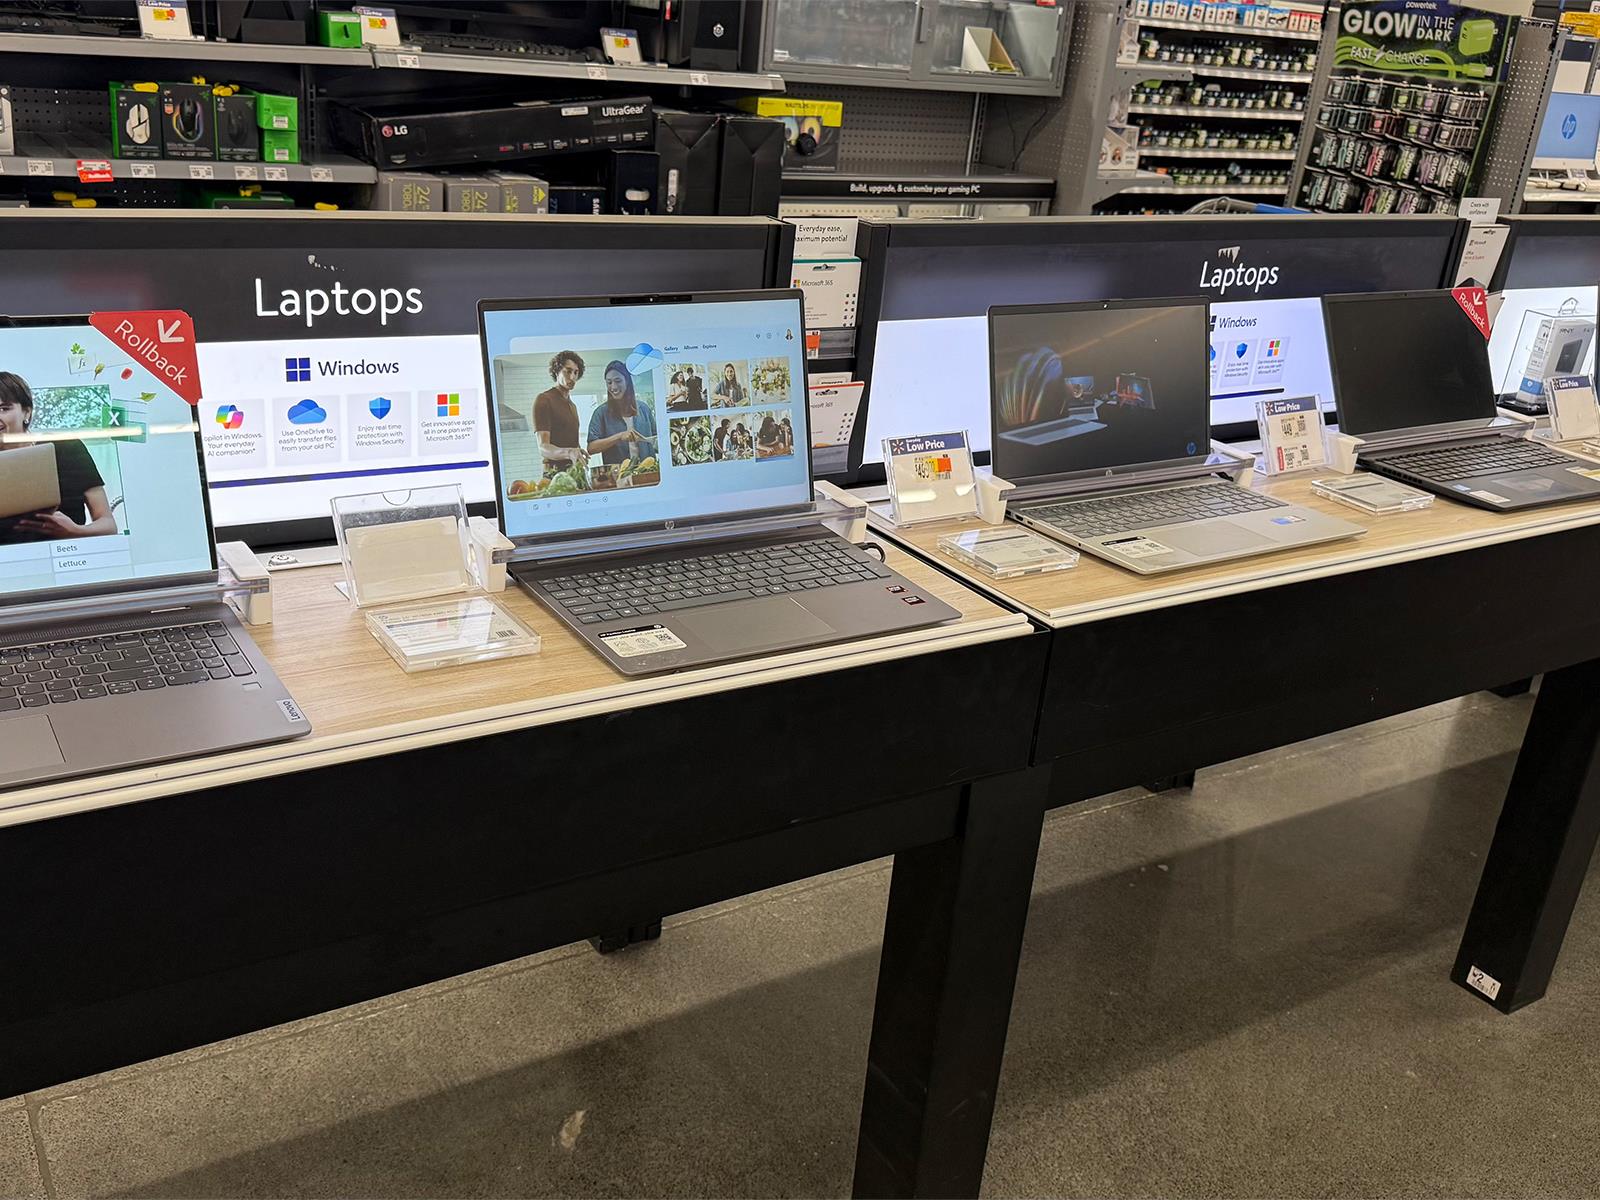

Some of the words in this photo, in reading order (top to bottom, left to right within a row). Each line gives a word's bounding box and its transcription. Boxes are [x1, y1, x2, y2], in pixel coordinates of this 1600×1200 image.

[1343, 9, 1417, 38] GLOW
[1418, 15, 1431, 26] IN
[1434, 16, 1455, 30] THE
[1416, 28, 1452, 41] DARK
[1350, 46, 1375, 59] FAST
[1385, 50, 1430, 66] CHARGE
[602, 105, 645, 117] UltraGear
[394, 125, 408, 135] LG
[903, 184, 933, 193] customize
[933, 186, 948, 194] your
[948, 185, 970, 194] gaming
[971, 184, 981, 192] PC
[799, 225, 826, 234] Everyday
[821, 234, 848, 243] potential
[1200, 261, 1280, 295] Laptops
[254, 278, 424, 327] Laptops
[1459, 292, 1486, 329] Rollback
[1219, 317, 1257, 328] Windows
[114, 319, 189, 386] Rollback
[318, 359, 400, 377] Windows
[108, 411, 120, 426] X
[204, 434, 223, 442] opilot
[295, 428, 325, 436] OneDrive
[907, 441, 924, 452] Low
[924, 440, 945, 450] Price
[56, 545, 78, 553] Beets
[58, 559, 87, 568] Lettuce
